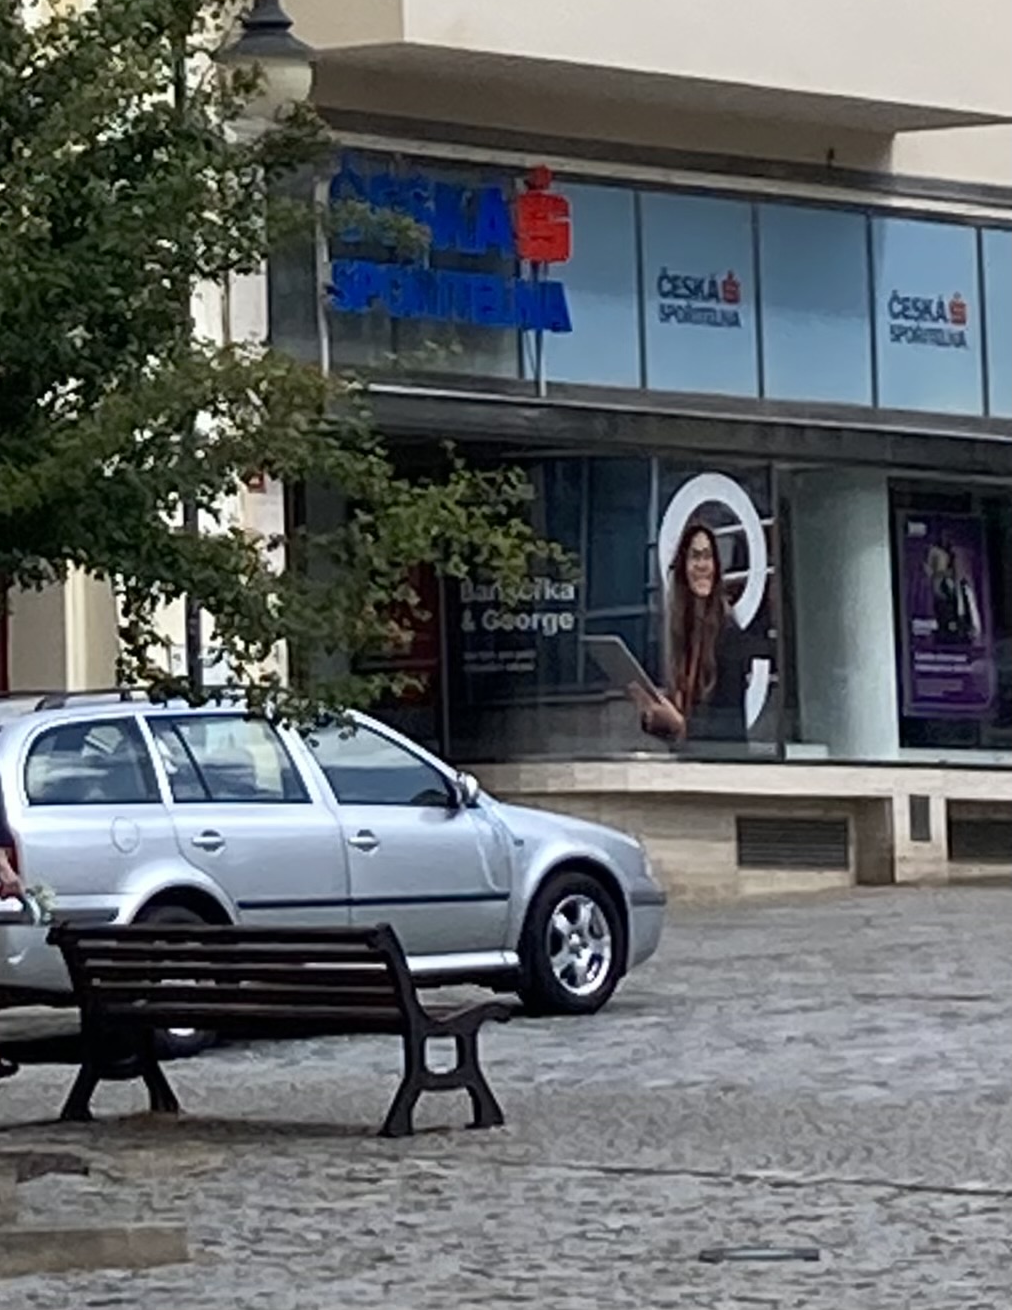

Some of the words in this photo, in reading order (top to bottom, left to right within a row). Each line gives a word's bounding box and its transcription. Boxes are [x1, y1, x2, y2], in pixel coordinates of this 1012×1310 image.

[658, 267, 721, 303] ČESKÁ
[888, 290, 950, 324] ČESKÁ
[481, 608, 576, 637] George
